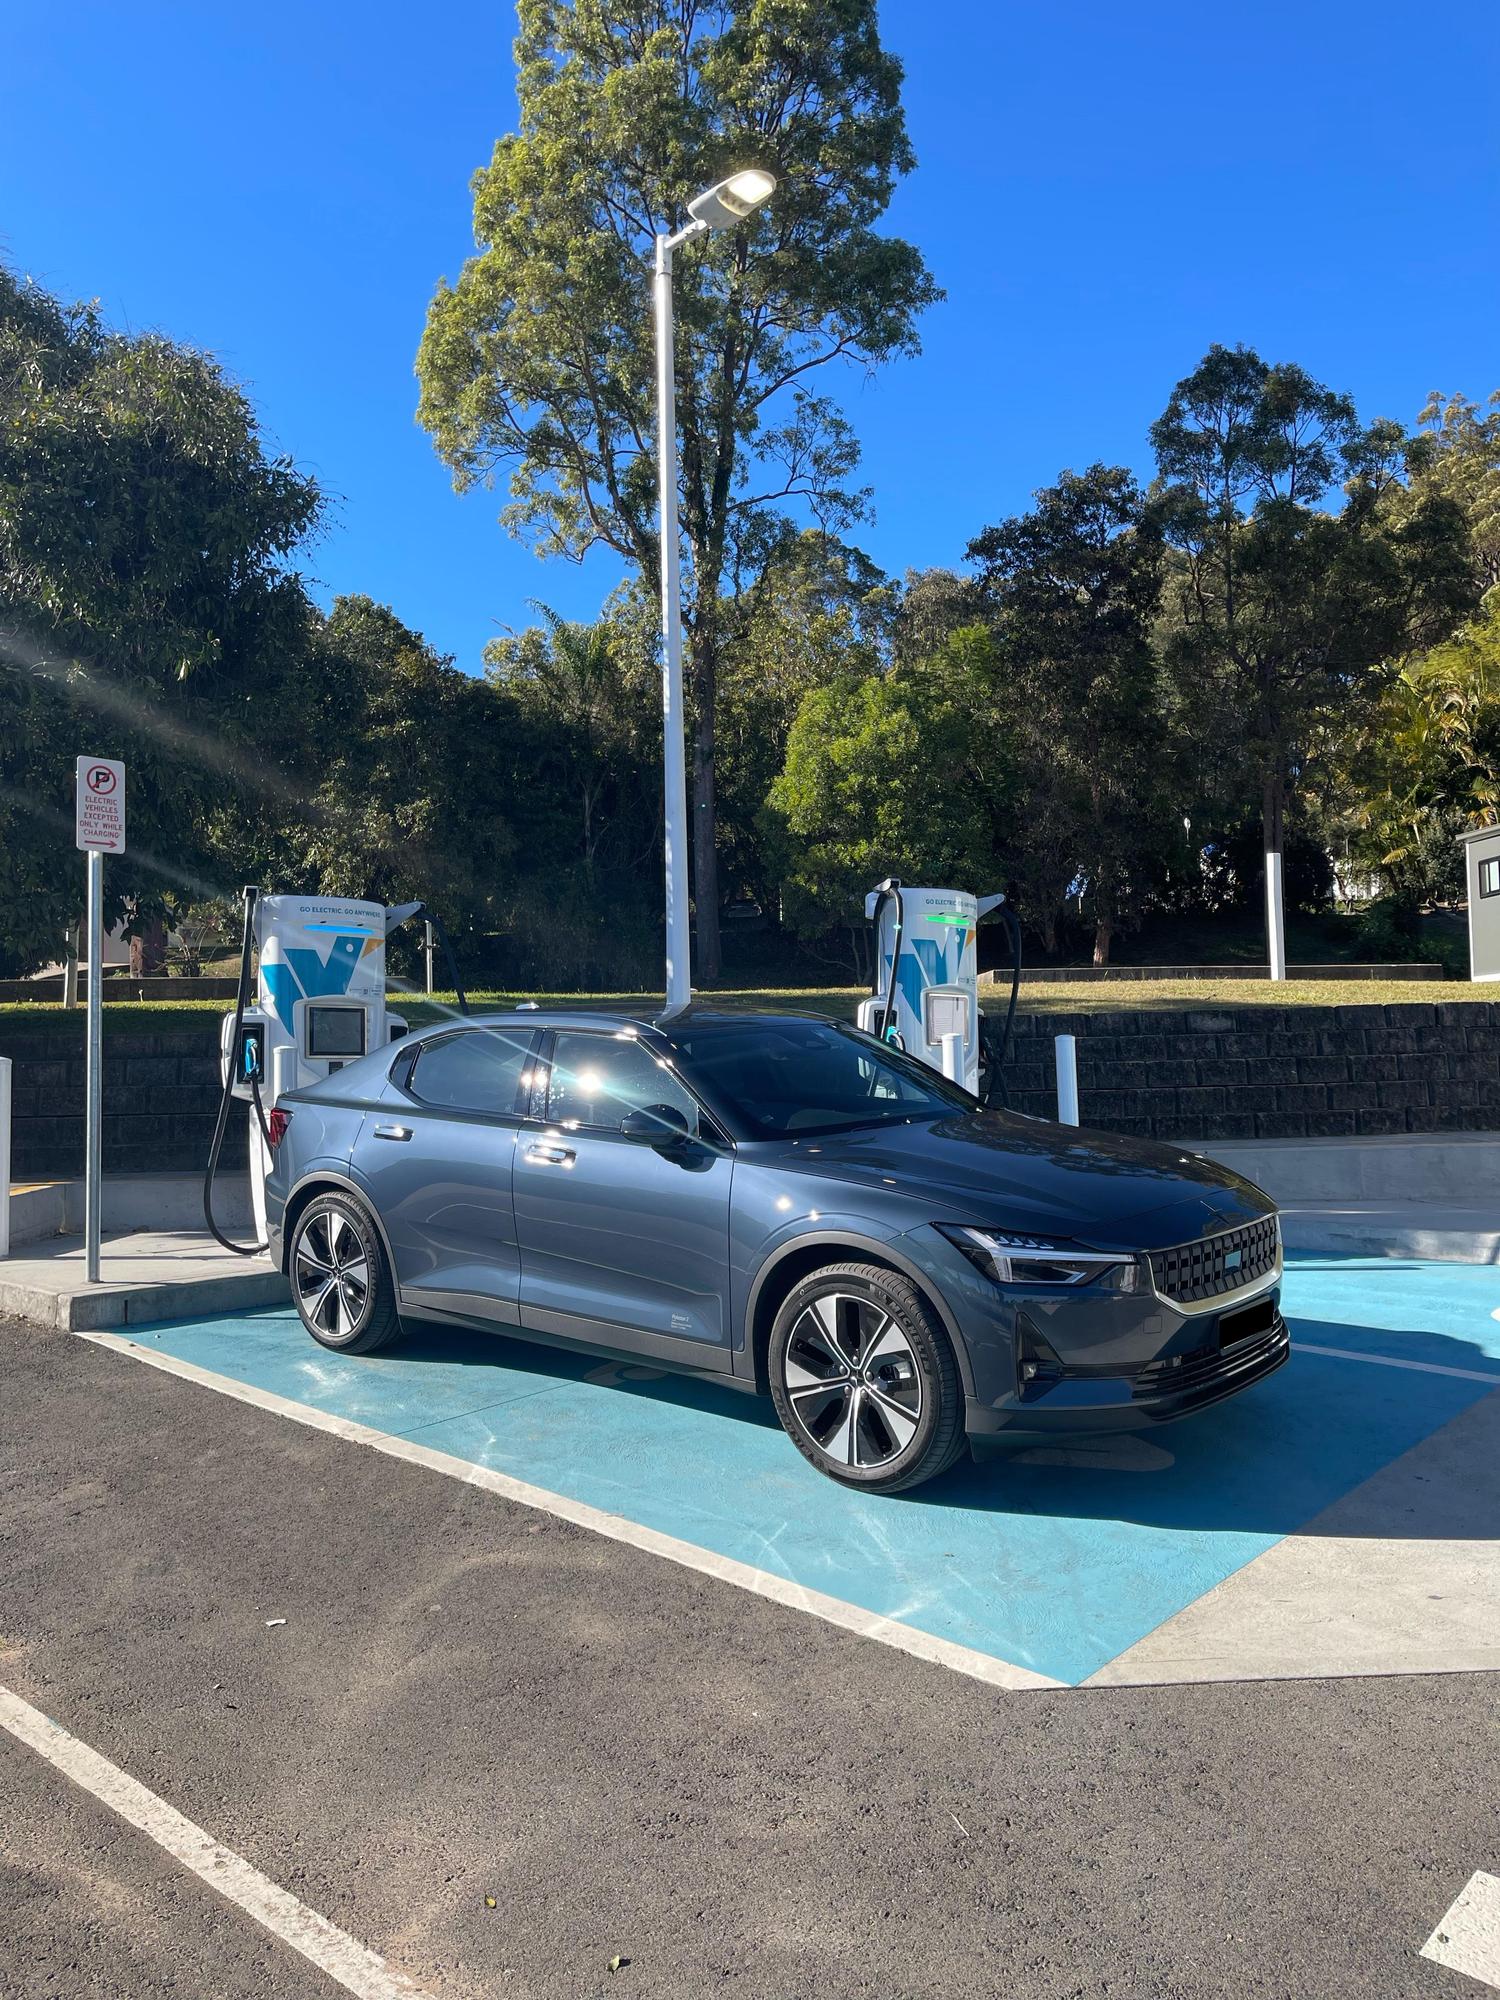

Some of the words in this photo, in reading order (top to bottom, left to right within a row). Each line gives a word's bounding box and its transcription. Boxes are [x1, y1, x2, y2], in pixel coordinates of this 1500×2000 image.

[85, 796, 117, 806] ELECTRIC
[85, 804, 118, 814] VEHICLES
[84, 812, 118, 822] EXCEPTED
[84, 829, 119, 838] CHARGING
